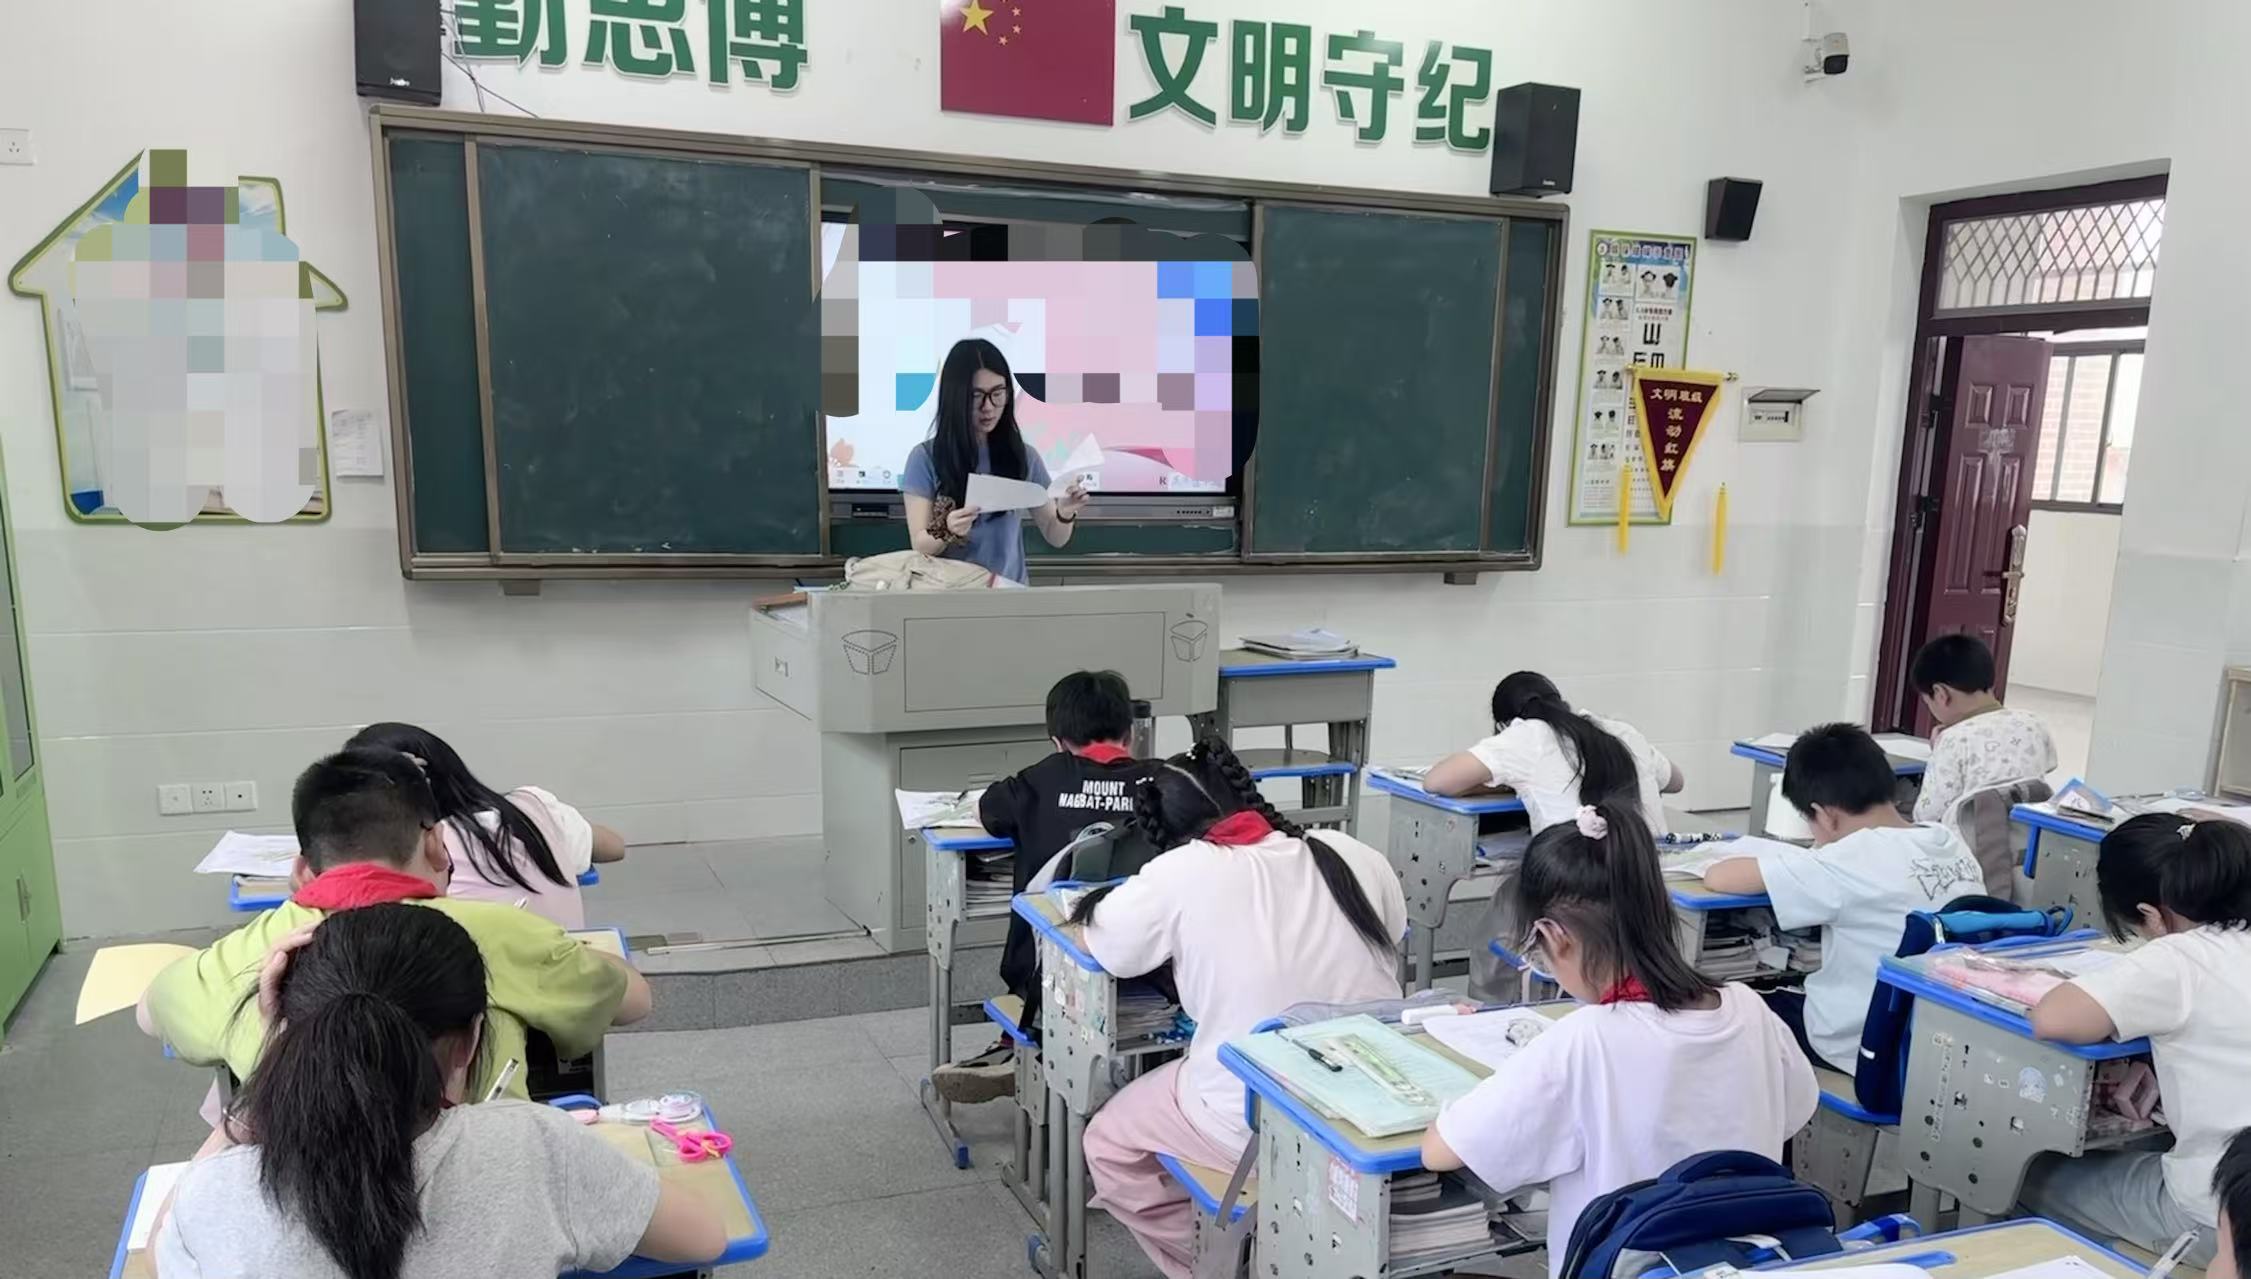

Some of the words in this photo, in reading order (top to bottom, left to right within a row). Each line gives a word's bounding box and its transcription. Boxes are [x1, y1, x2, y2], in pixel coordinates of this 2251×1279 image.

[1128, 6, 1494, 151] 文明守纪
[1650, 388, 1702, 403] 文明班级
[1660, 407, 1684, 472] 流动红旗
[1082, 780, 1125, 796] MOUNT
